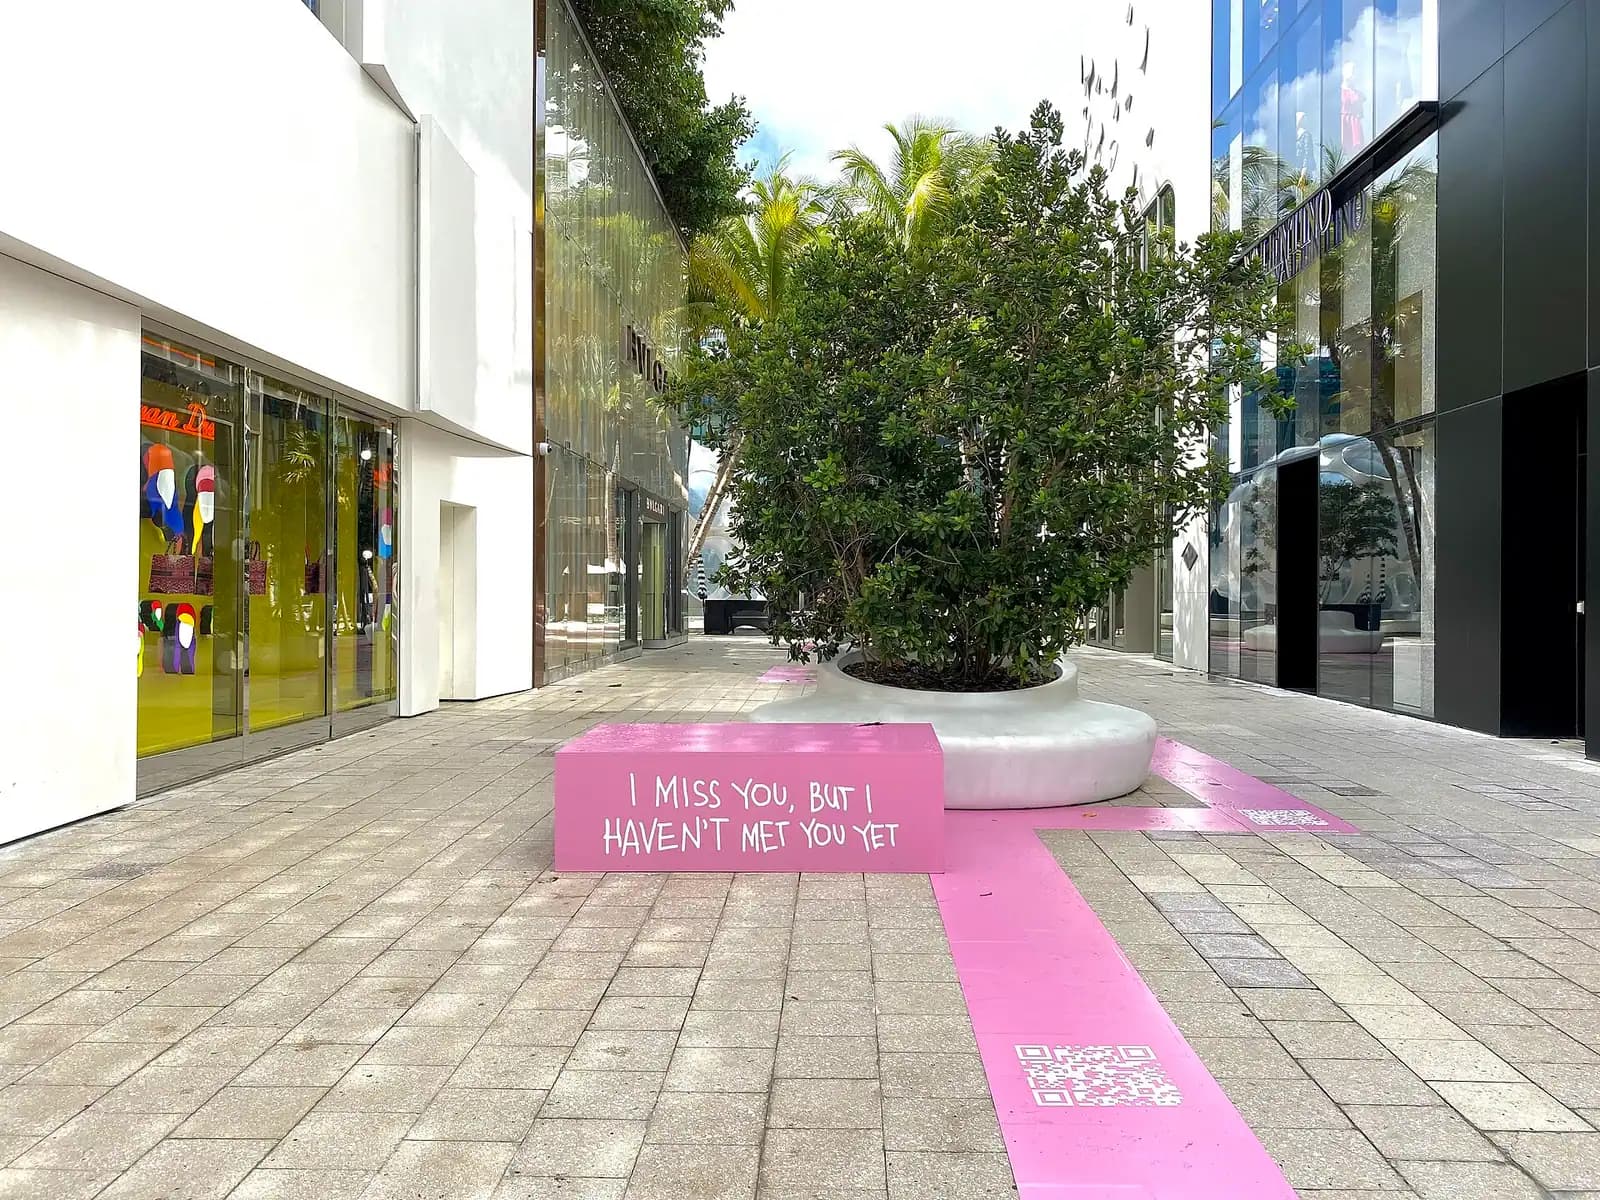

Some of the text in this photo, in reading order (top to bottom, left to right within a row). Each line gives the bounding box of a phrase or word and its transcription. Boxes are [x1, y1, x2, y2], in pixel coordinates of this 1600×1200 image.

[629, 772, 873, 814] I MISS YOU, BUT I
[602, 816, 900, 857] HAVEN'T MET YOU YET
